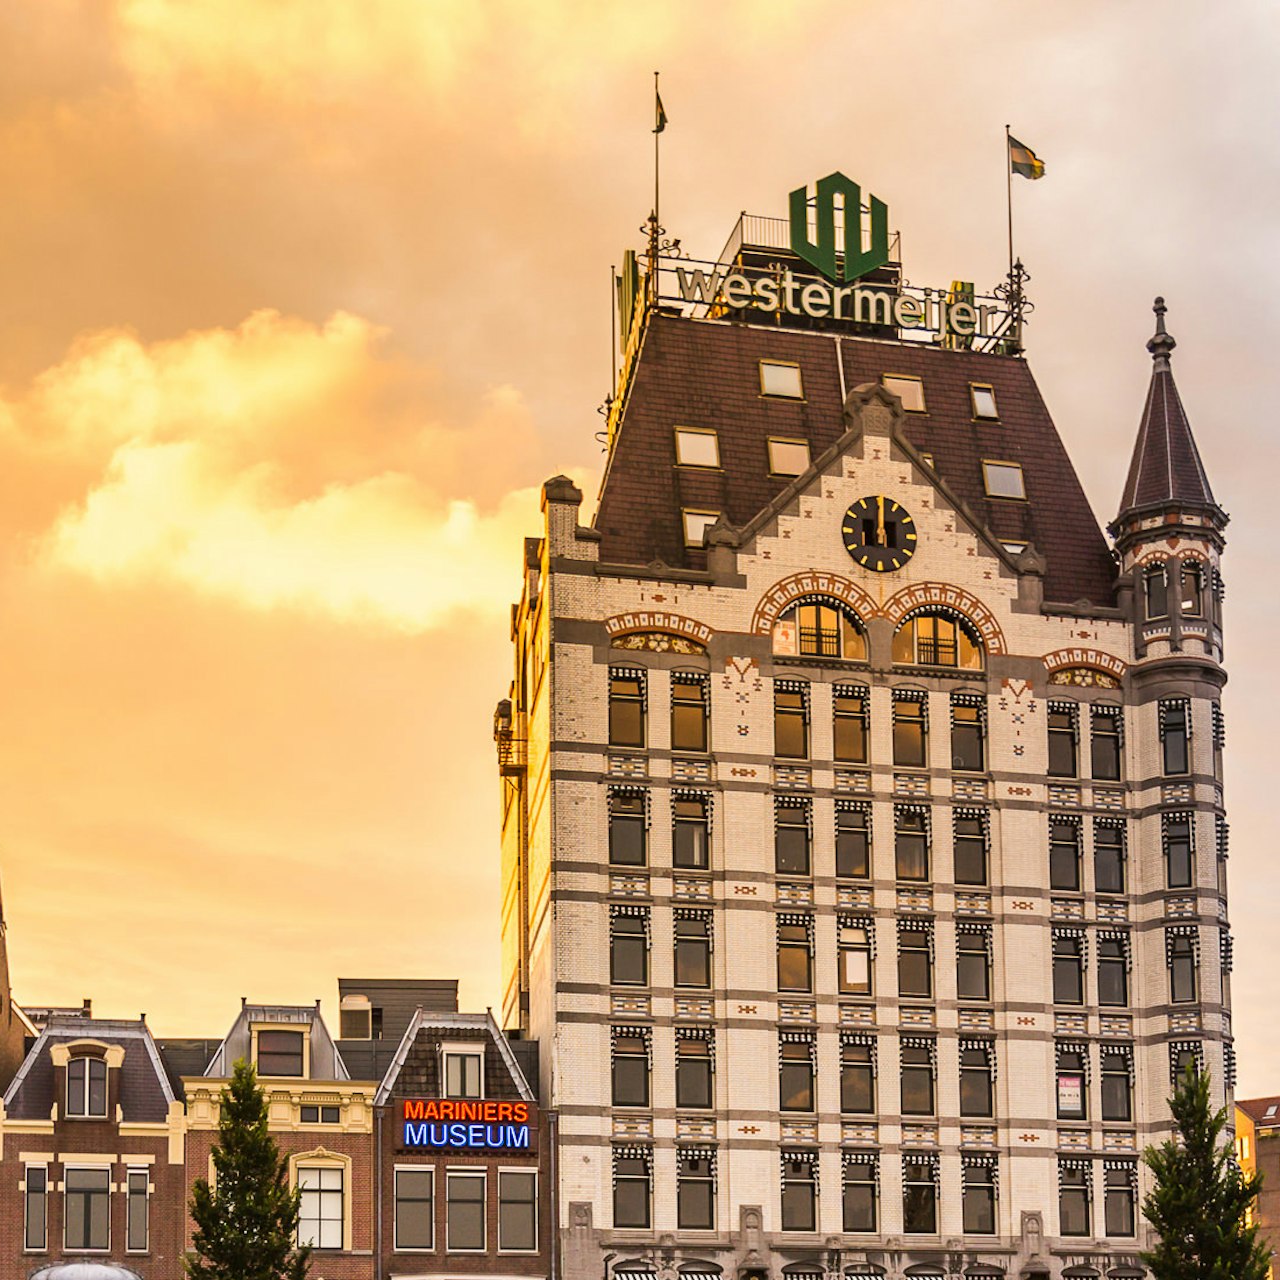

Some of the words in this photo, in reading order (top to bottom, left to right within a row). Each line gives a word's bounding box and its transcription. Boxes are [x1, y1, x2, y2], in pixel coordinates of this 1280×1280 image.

[677, 266, 998, 342] westermeijer
[404, 1100, 529, 1122] MARINIERS
[404, 1122, 529, 1148] MUSEUM
